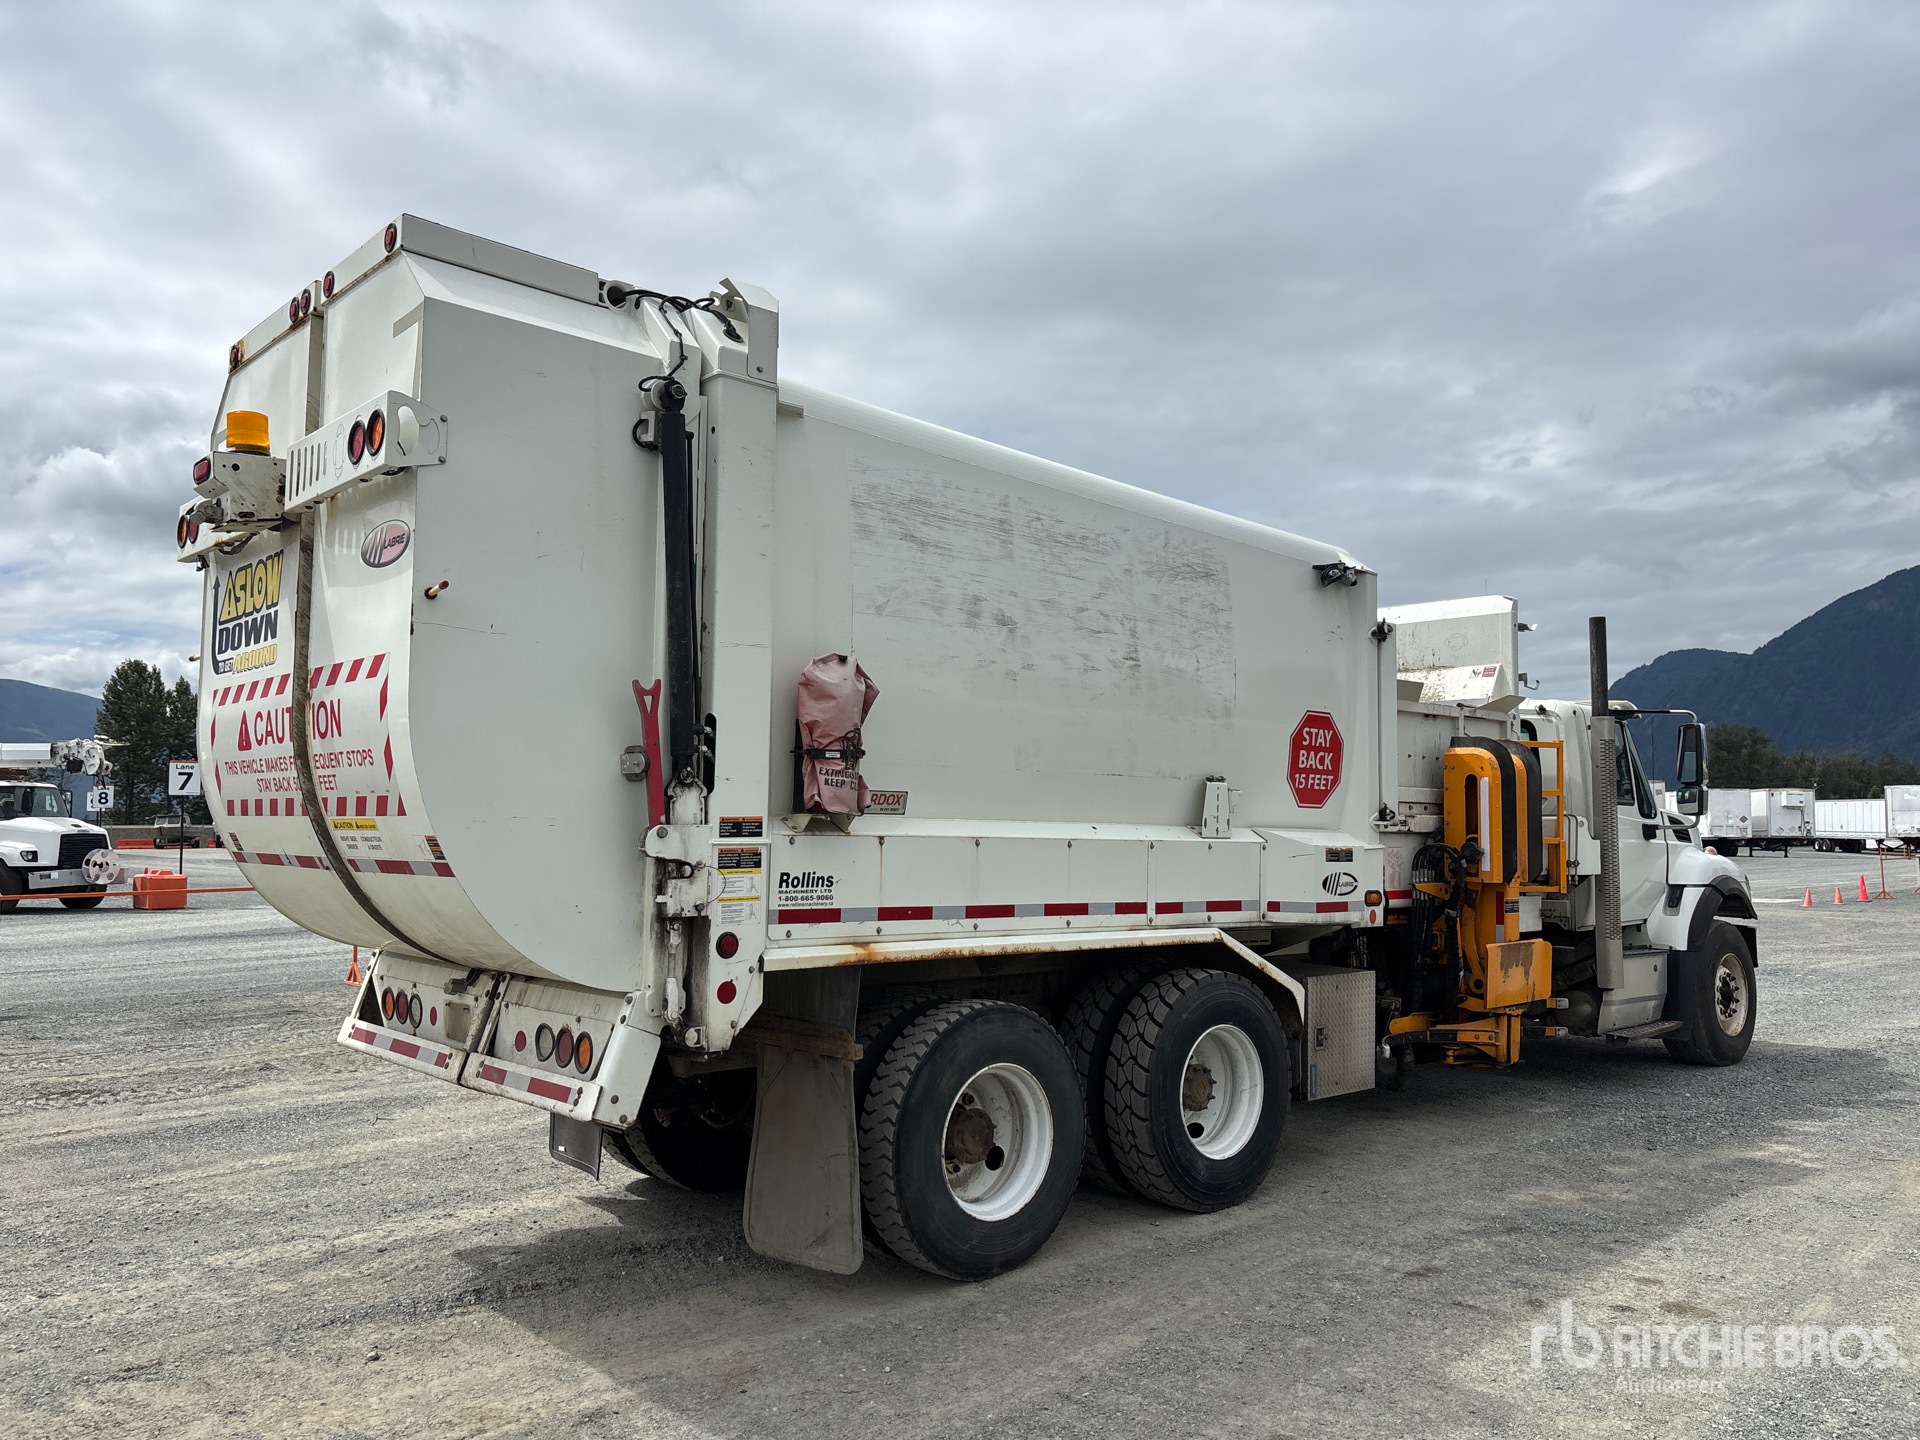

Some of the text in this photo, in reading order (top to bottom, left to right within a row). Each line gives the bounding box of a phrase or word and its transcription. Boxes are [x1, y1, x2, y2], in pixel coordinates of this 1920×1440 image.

[233, 549, 284, 619] SLOW
[217, 609, 279, 656] DOWN
[232, 643, 278, 675] AROUND
[1302, 727, 1333, 748] STAY
[225, 761, 238, 776] THIS
[238, 758, 265, 774] VEHICLE
[264, 755, 289, 772] MAKES
[345, 748, 374, 768] STOPS
[1298, 749, 1333, 771] BACK
[178, 772, 194, 790] 7
[256, 777, 272, 793] STAY
[272, 776, 293, 792] BACK
[317, 774, 338, 791] FEET
[824, 777, 846, 788] KEEP
[1294, 773, 1334, 791] 15 FEET
[98, 791, 109, 805] 8
[871, 793, 903, 806] RDOX
[778, 871, 835, 889] Rollins
[778, 894, 834, 902] 1-800-665-9060
